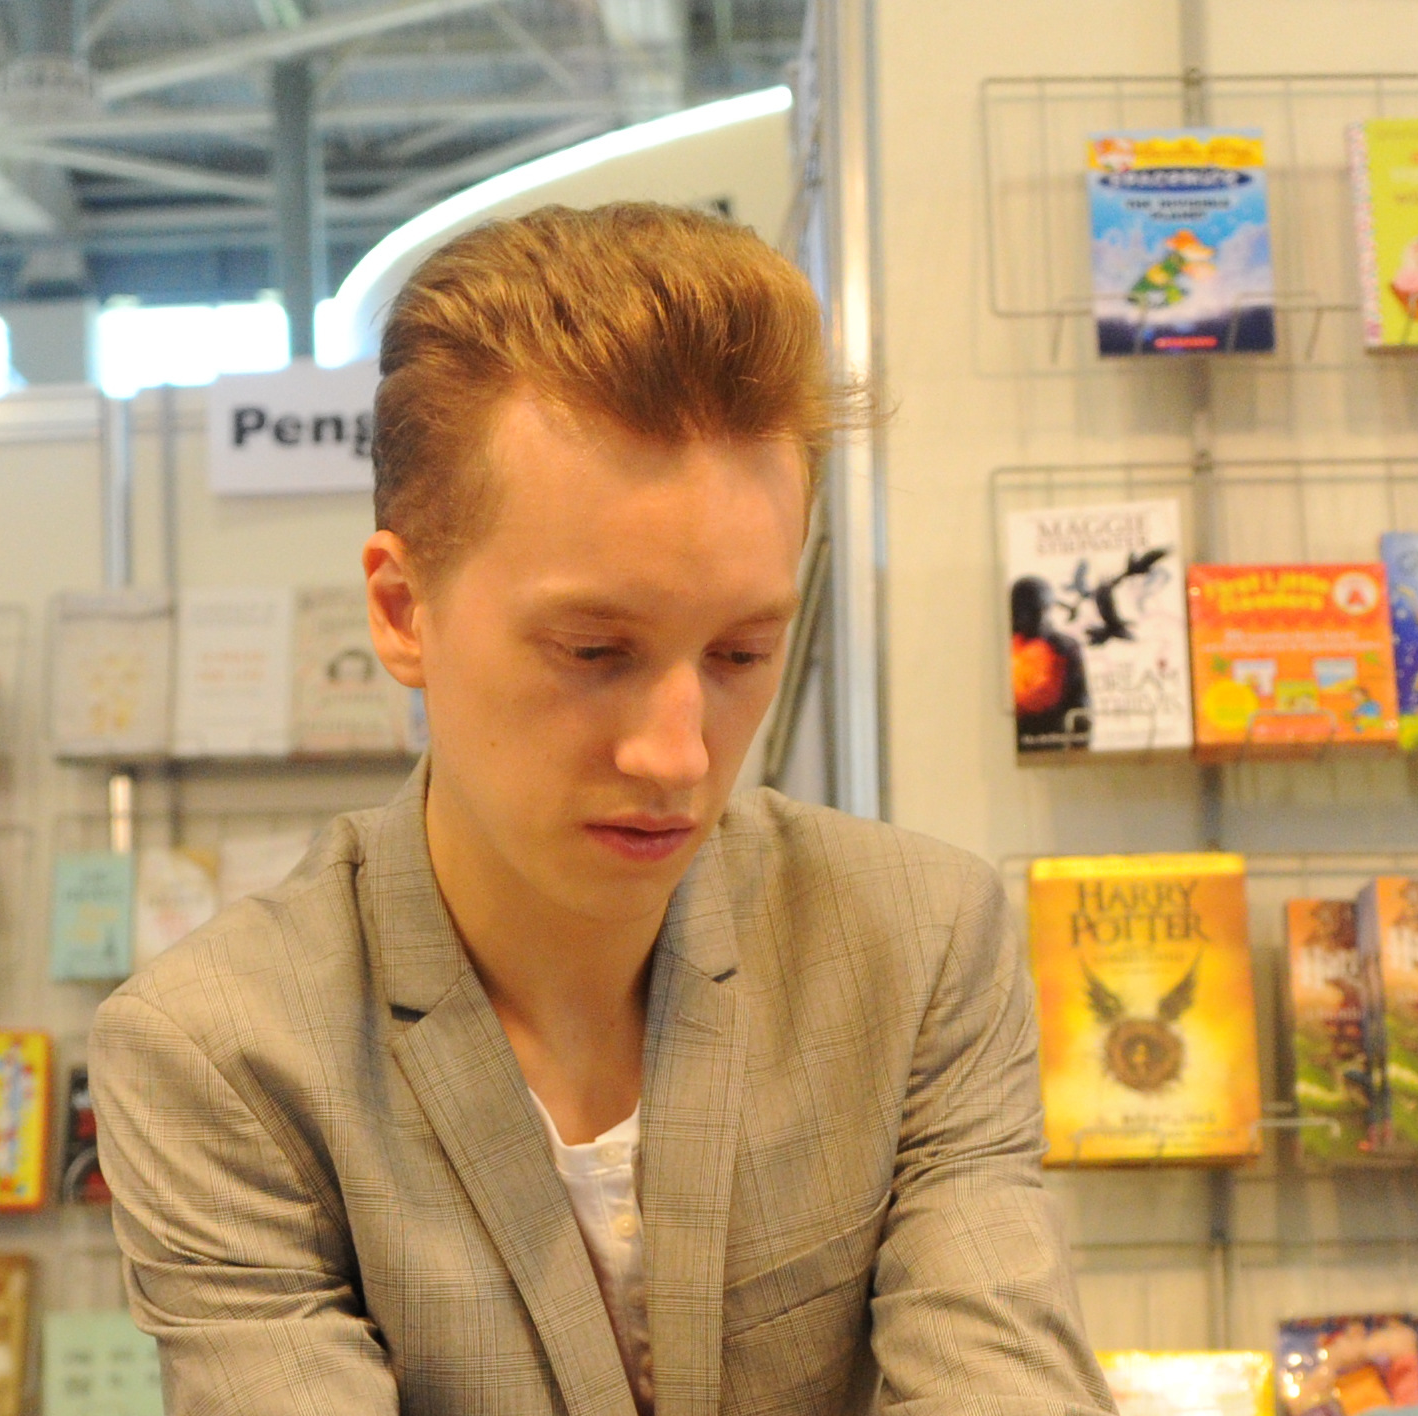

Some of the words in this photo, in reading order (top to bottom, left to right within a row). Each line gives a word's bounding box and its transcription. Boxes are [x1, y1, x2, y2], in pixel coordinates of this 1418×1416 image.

[1035, 516, 1145, 541] MAGGIE
[1074, 879, 1199, 912] HARRY
[1068, 910, 1211, 948] POTTER
